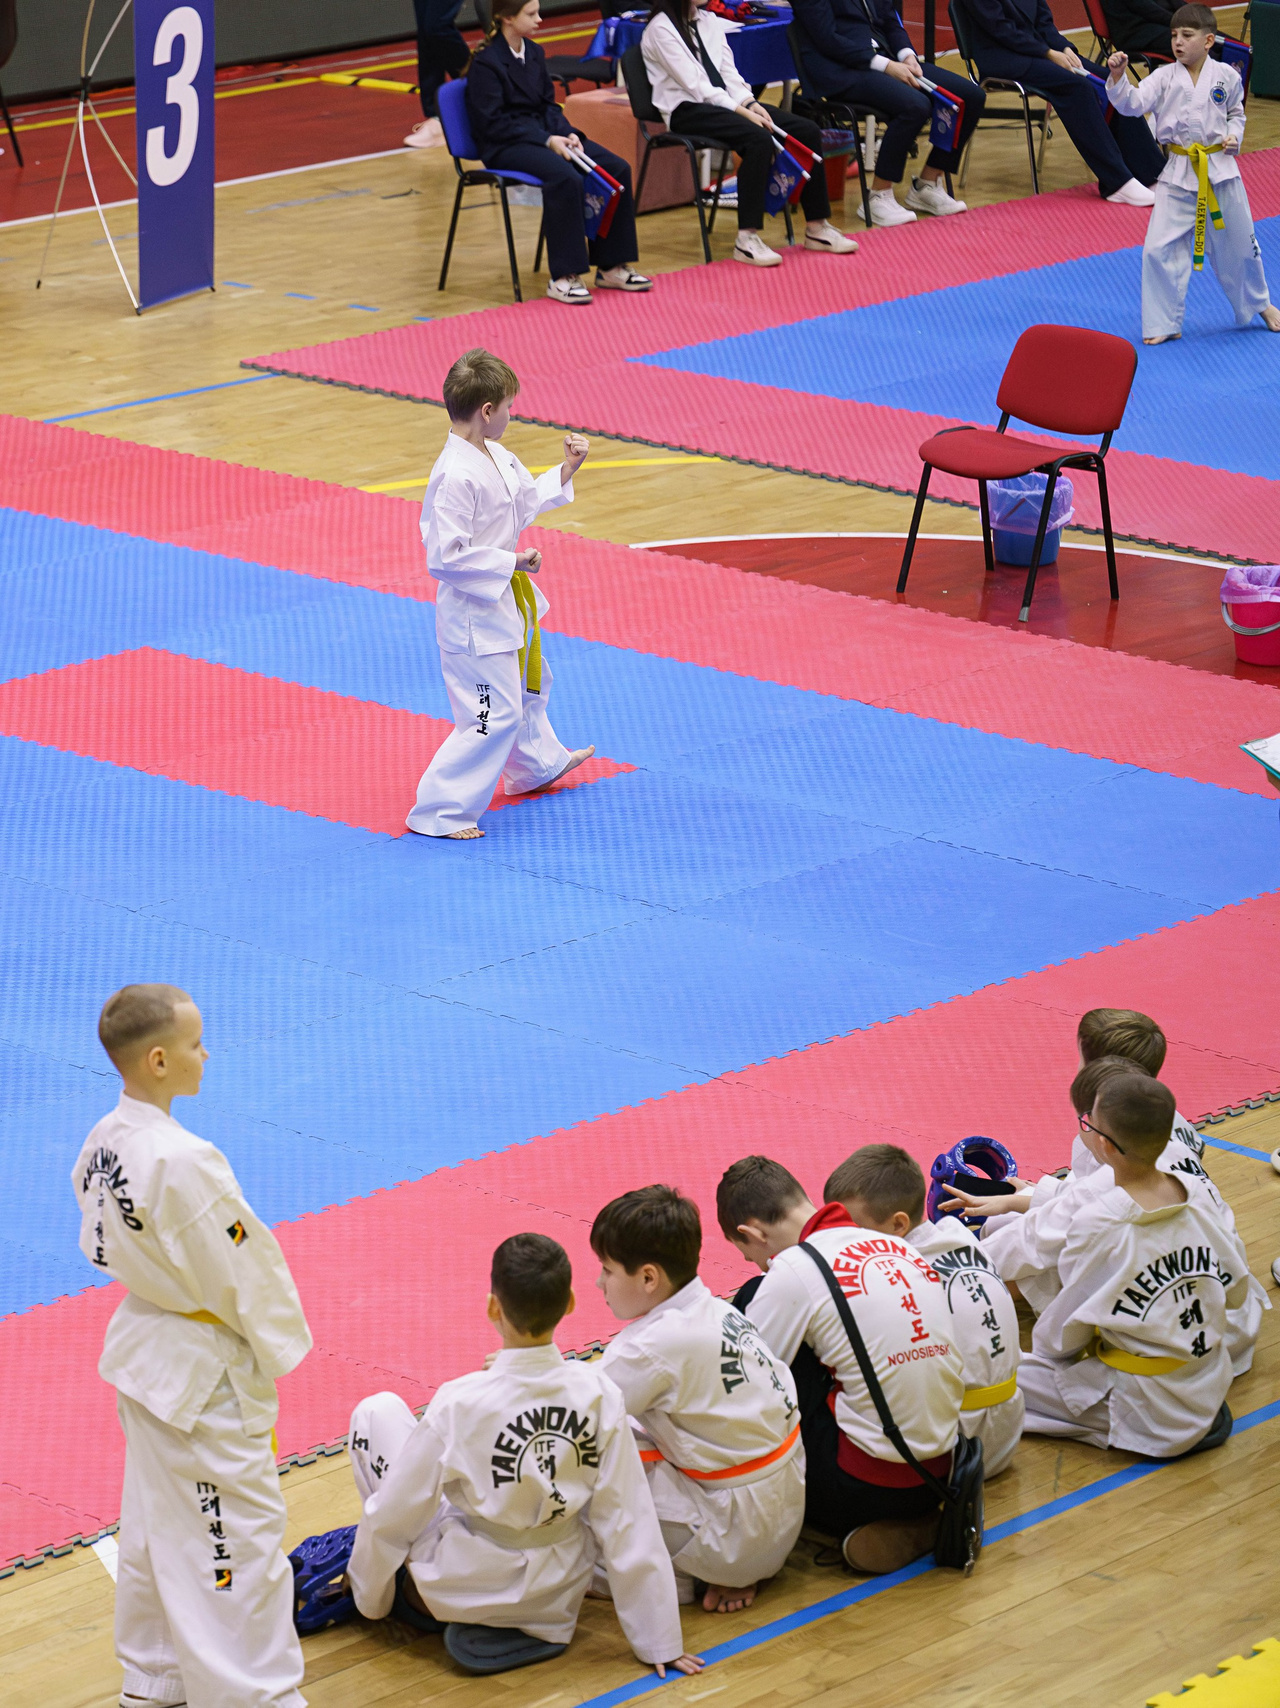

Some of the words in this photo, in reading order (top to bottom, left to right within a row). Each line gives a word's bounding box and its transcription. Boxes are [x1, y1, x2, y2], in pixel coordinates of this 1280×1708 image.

[145, 6, 204, 187] 3
[1195, 196, 1207, 253] TAEKWON-DO
[475, 683, 490, 693] ITF
[875, 1259, 896, 1271] ITF
[960, 1272, 979, 1286] ITF
[1173, 1280, 1197, 1303] ITF
[535, 1440, 555, 1454] ITF
[197, 1482, 219, 1494] ITF
